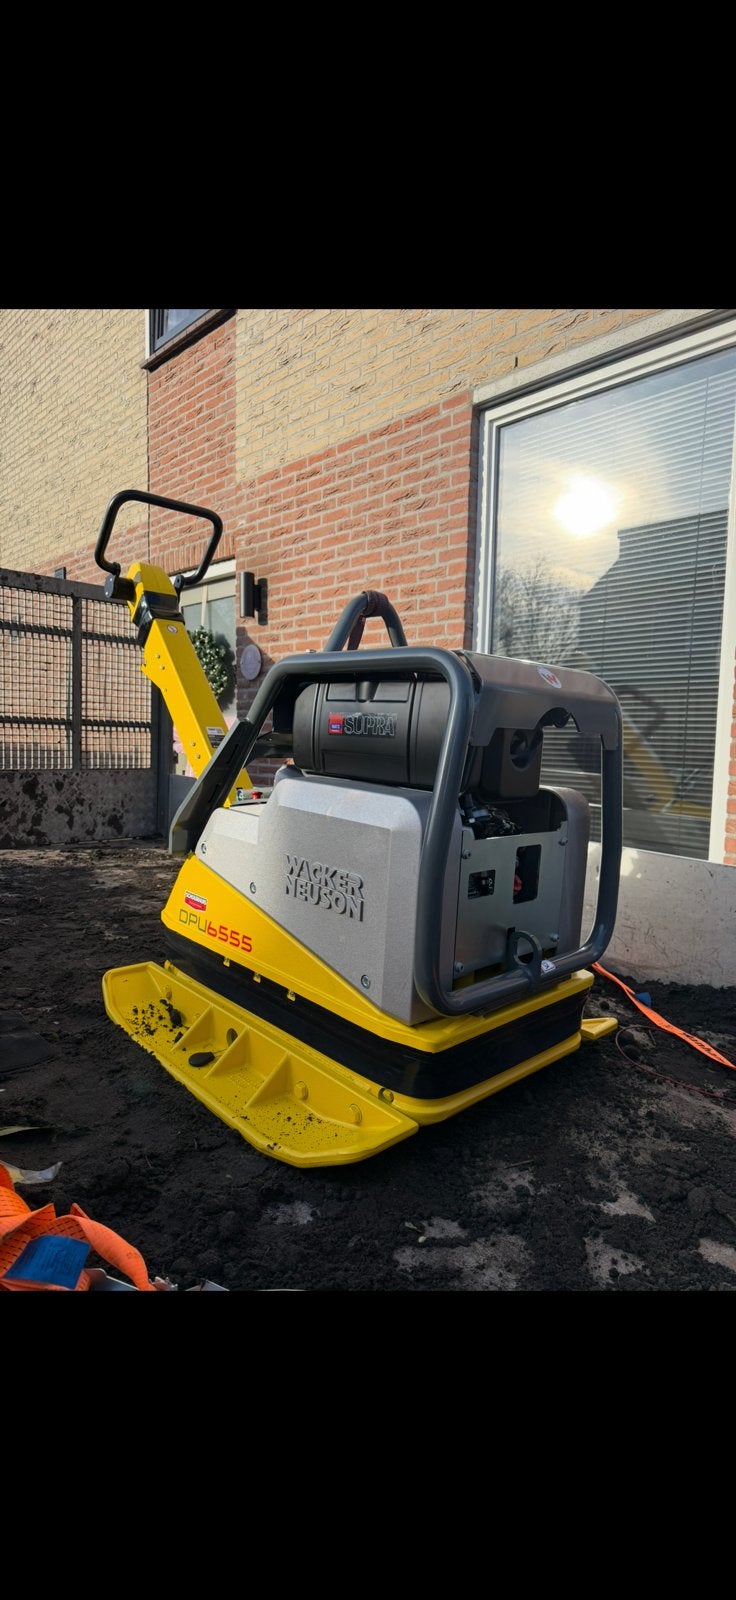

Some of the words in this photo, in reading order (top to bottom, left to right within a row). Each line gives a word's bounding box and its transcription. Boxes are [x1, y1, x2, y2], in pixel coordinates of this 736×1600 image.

[344, 714, 395, 736] SUPRA
[284, 854, 364, 899] WACKER
[285, 874, 364, 922] NEUSON
[179, 908, 252, 953] DPU6555
